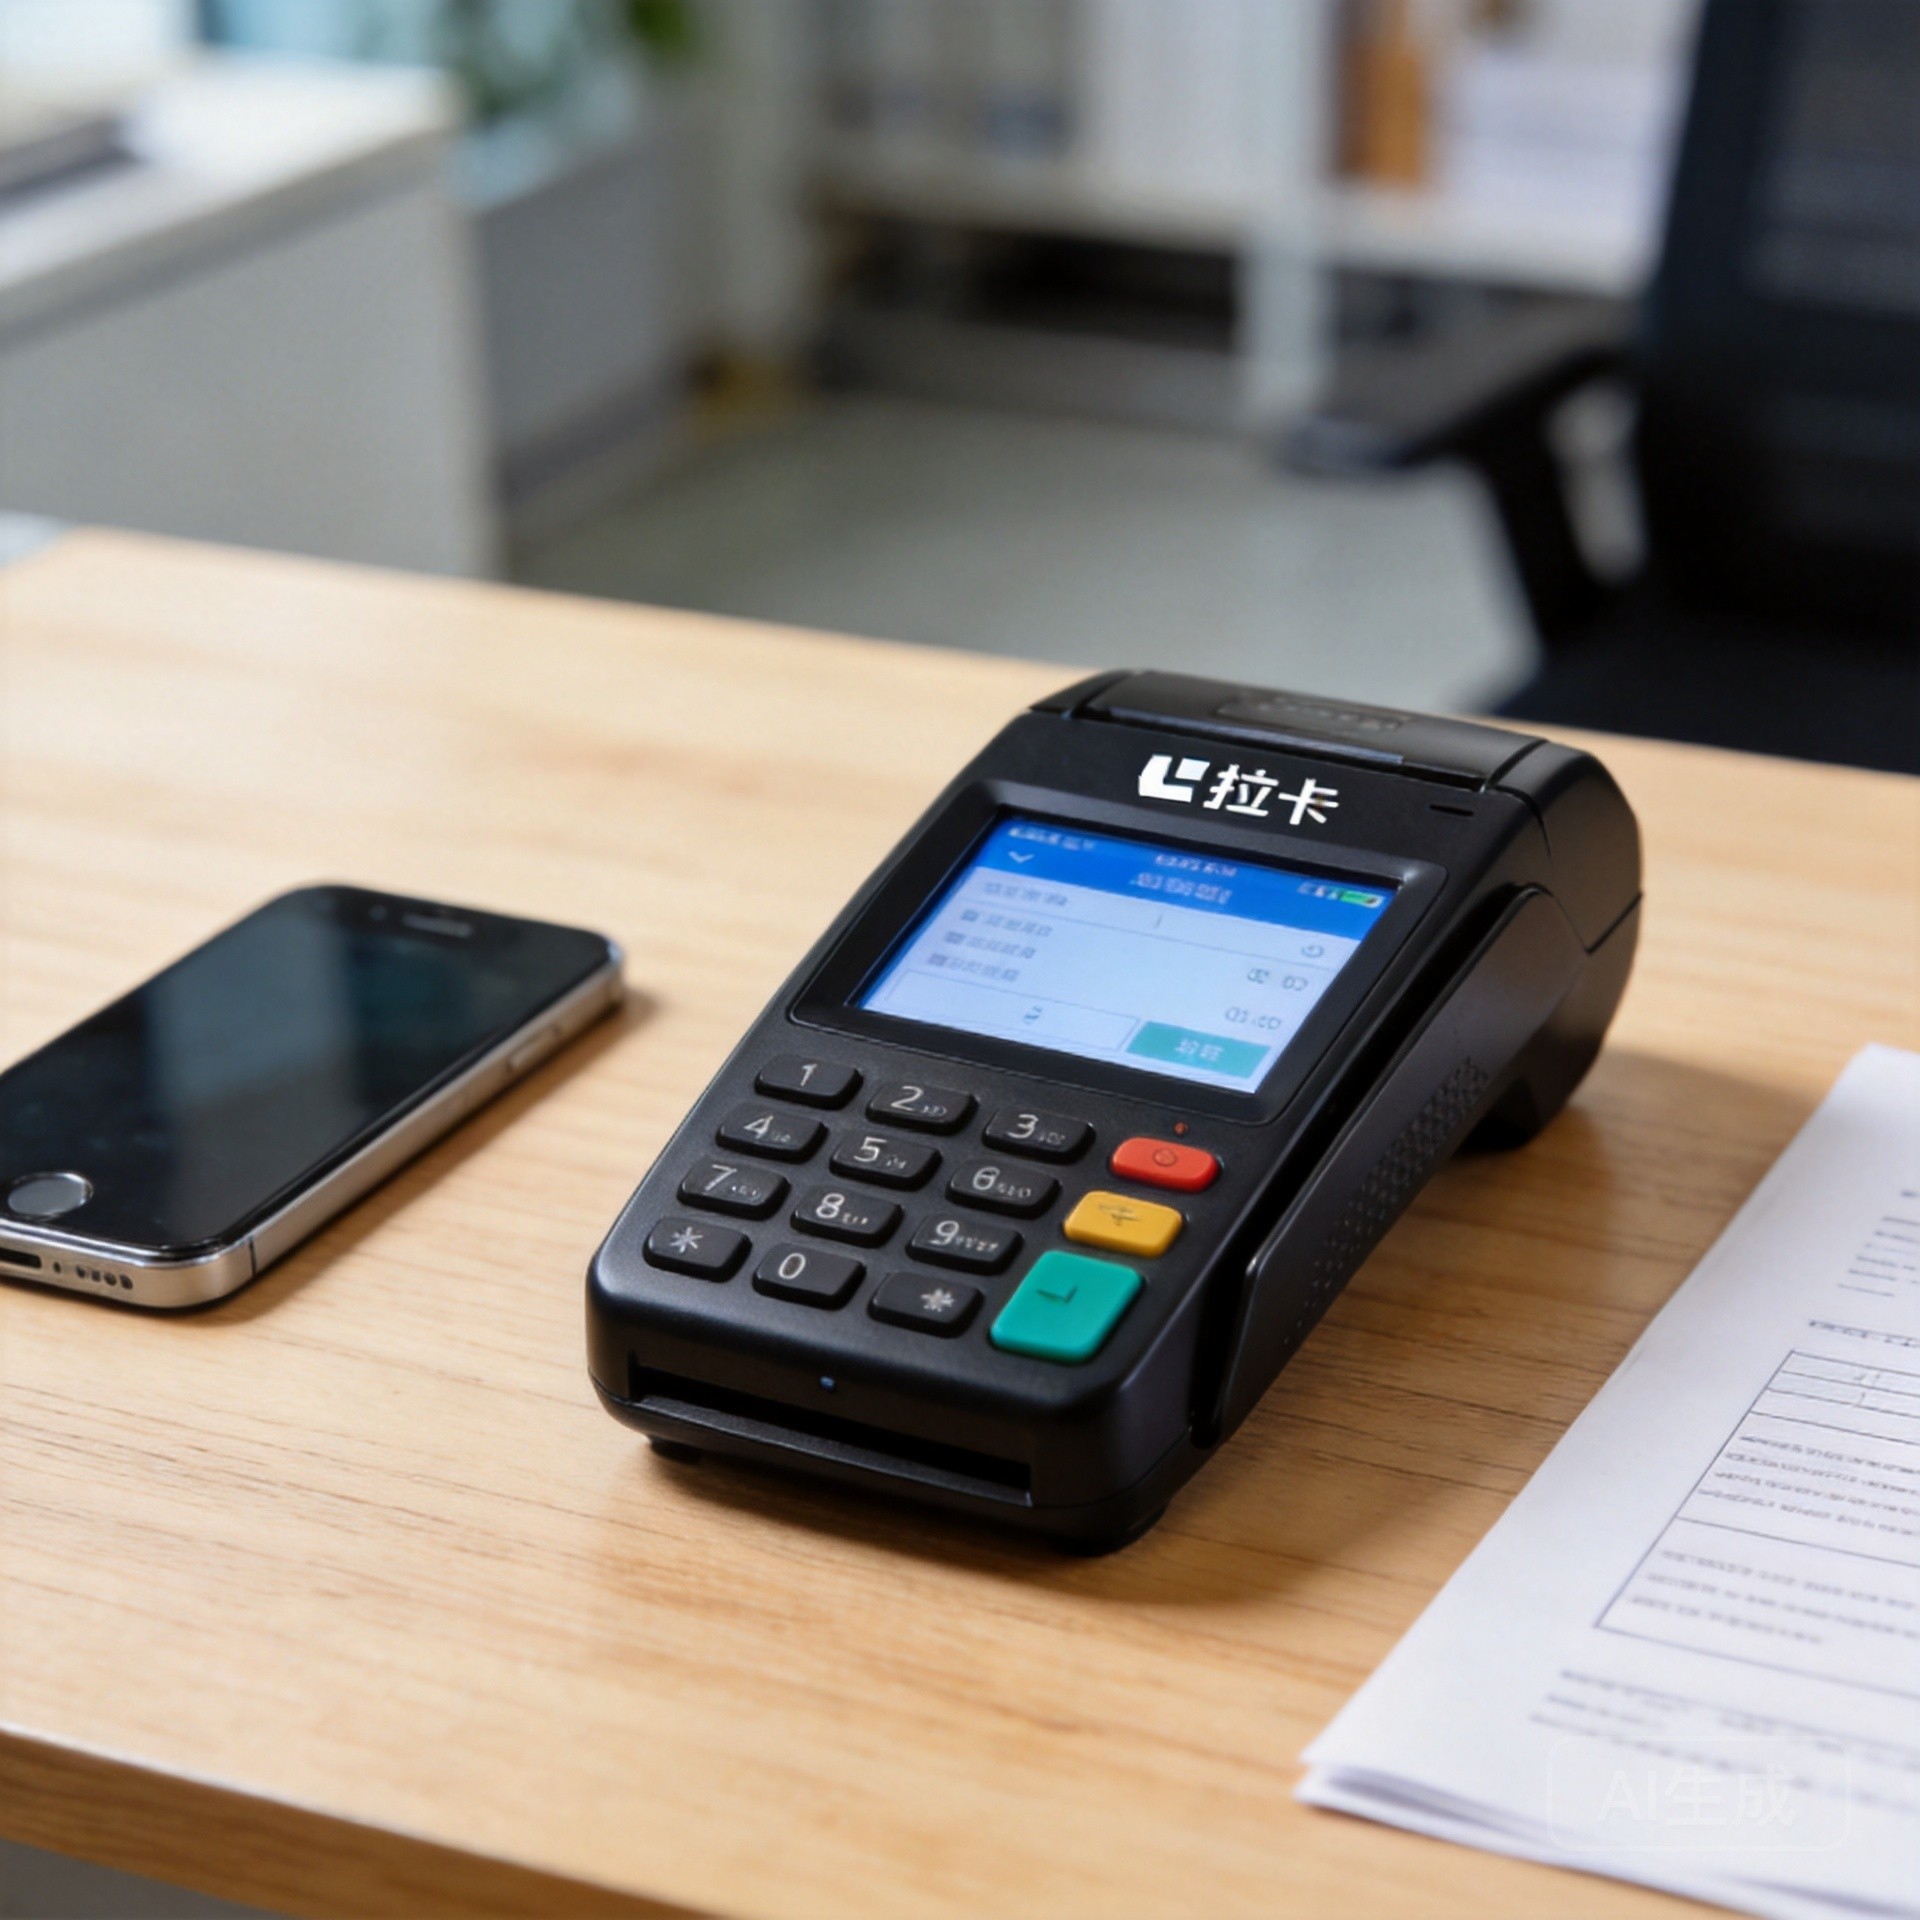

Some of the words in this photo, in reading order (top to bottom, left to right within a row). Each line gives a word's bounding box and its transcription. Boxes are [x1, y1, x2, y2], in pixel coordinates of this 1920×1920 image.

[1203, 763, 1339, 825] 拉卡
[800, 1063, 818, 1086] 1
[890, 1085, 924, 1112] 2
[743, 1115, 774, 1138] 4
[1007, 1114, 1039, 1138] 3
[853, 1137, 887, 1162] 5
[704, 1164, 737, 1191] 7
[816, 1193, 845, 1218] 8
[929, 1220, 960, 1245] 9
[778, 1253, 806, 1279] 0
